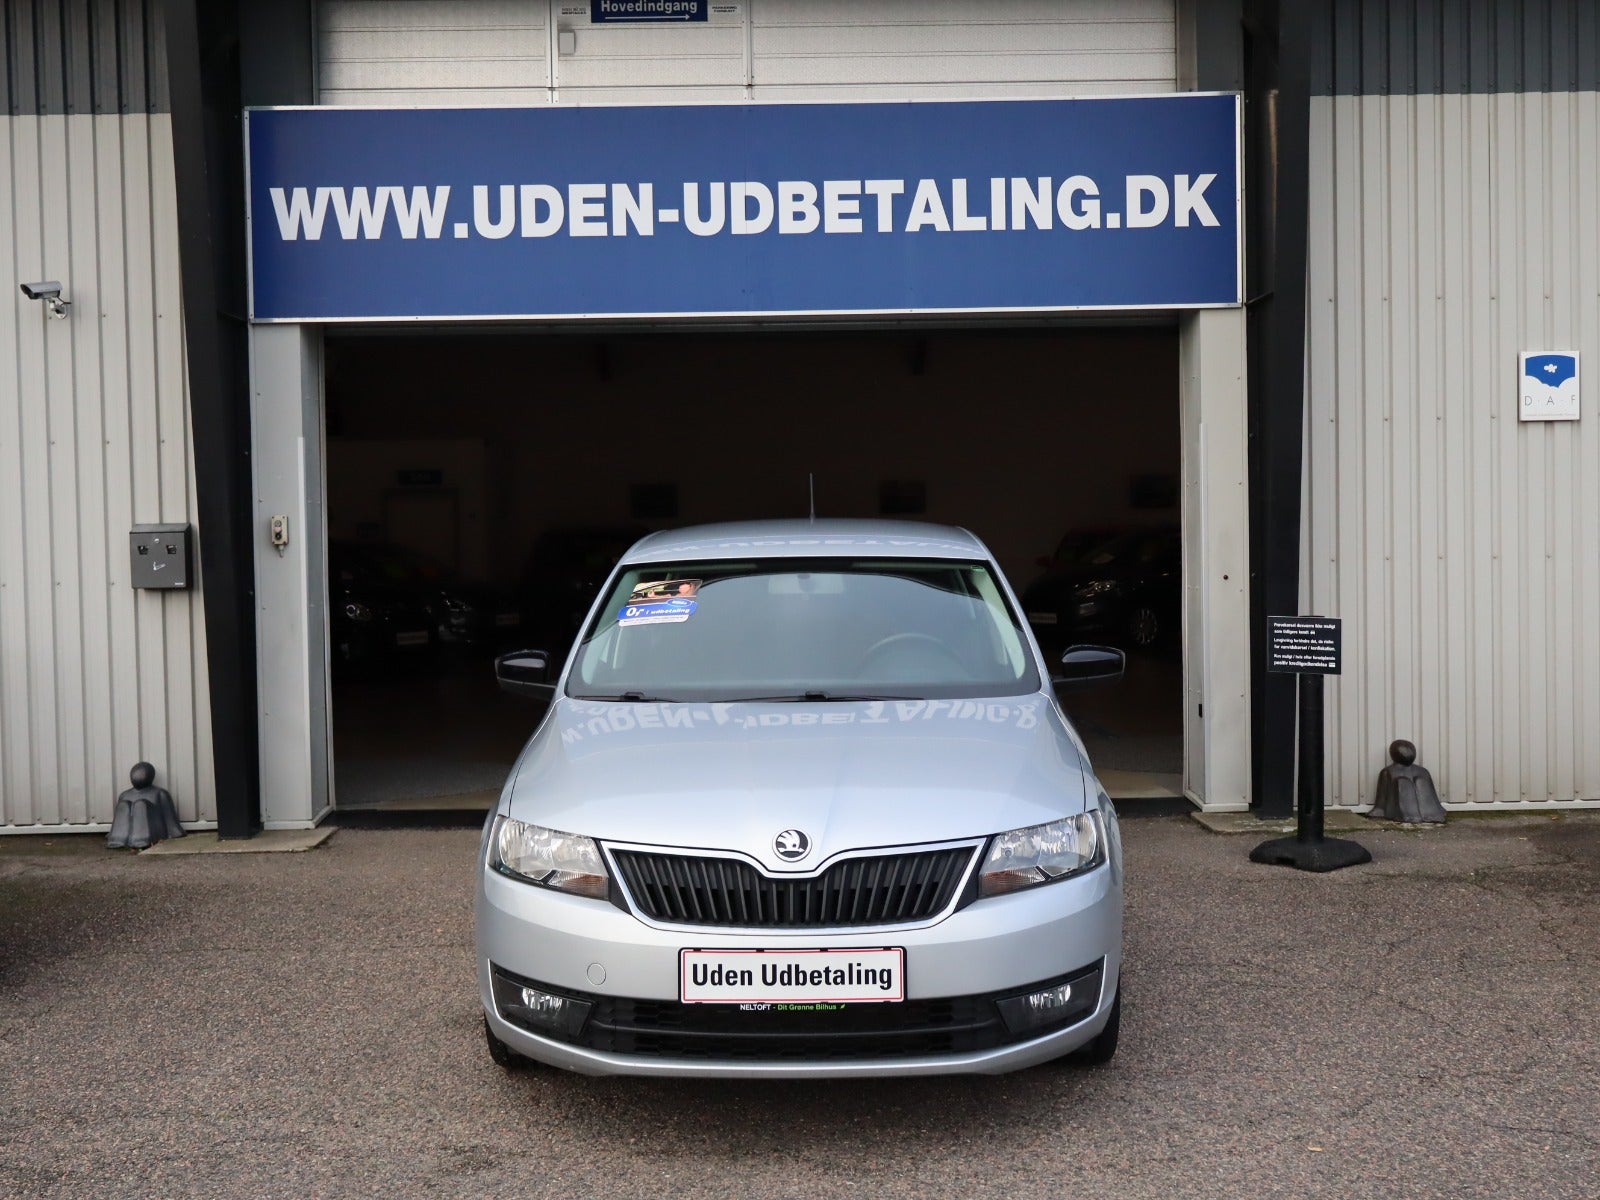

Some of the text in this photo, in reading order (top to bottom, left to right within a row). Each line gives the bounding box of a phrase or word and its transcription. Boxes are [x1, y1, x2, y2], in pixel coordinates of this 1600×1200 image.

[601, 0, 697, 13] Hovedindgang
[269, 172, 1221, 241] WWW.UDEN-UDBETALING.DK
[692, 962, 892, 990] Uden Udbetaling
